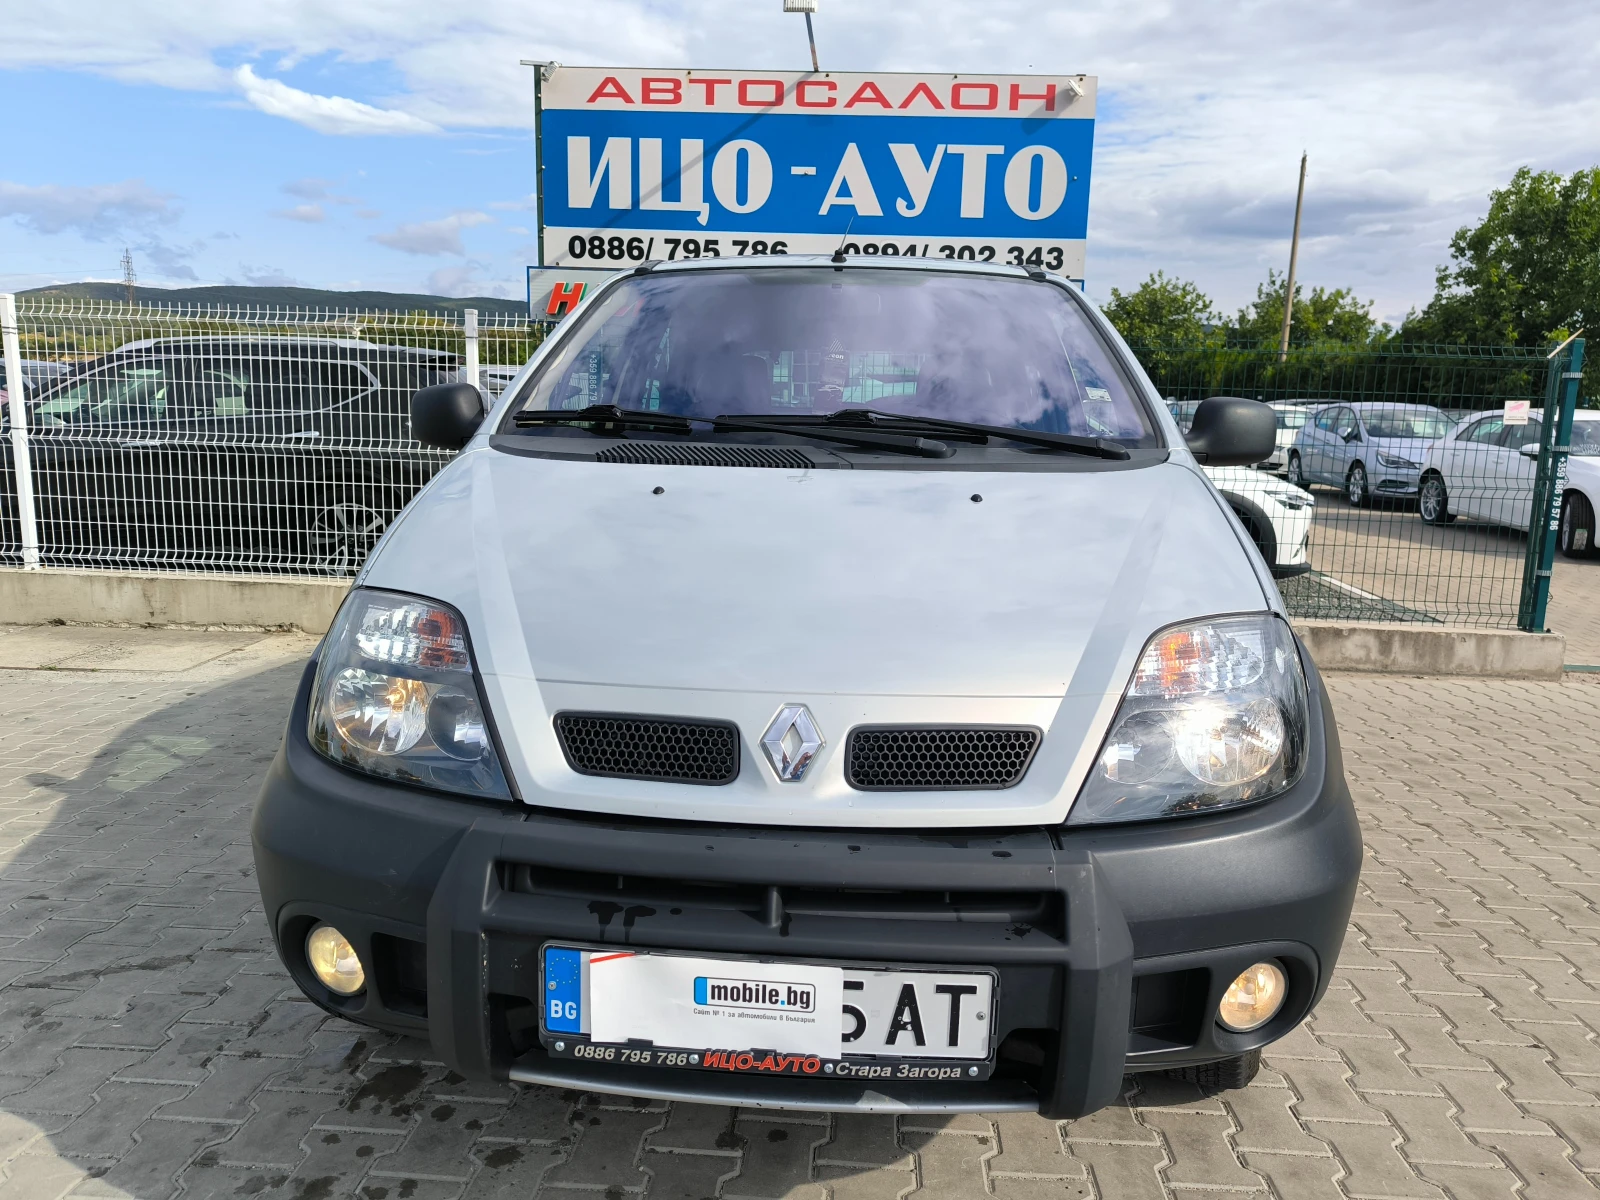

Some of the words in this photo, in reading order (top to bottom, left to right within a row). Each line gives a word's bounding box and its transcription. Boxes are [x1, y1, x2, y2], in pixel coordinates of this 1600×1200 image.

[586, 77, 1056, 111] АВТОСАЛОН
[568, 235, 654, 260] 0886/
[664, 238, 720, 260] 795
[1006, 246, 1064, 270] 343
[1557, 456, 1567, 477] +359
[1553, 496, 1563, 507] 79
[1551, 508, 1560, 519] 57
[1550, 520, 1559, 531] 86
[710, 983, 811, 1010] mobile.bg
[550, 999, 577, 1020] BG
[693, 1008, 711, 1016] Сайт
[737, 1012, 777, 1021] автомобили
[785, 1015, 816, 1024] България
[574, 1045, 616, 1061] 0886
[620, 1049, 652, 1064] 795
[656, 1051, 689, 1066] 786
[703, 1050, 821, 1074] ИЦО-АУТО
[835, 1062, 892, 1078] Стара
[896, 1064, 962, 1080] Загора
